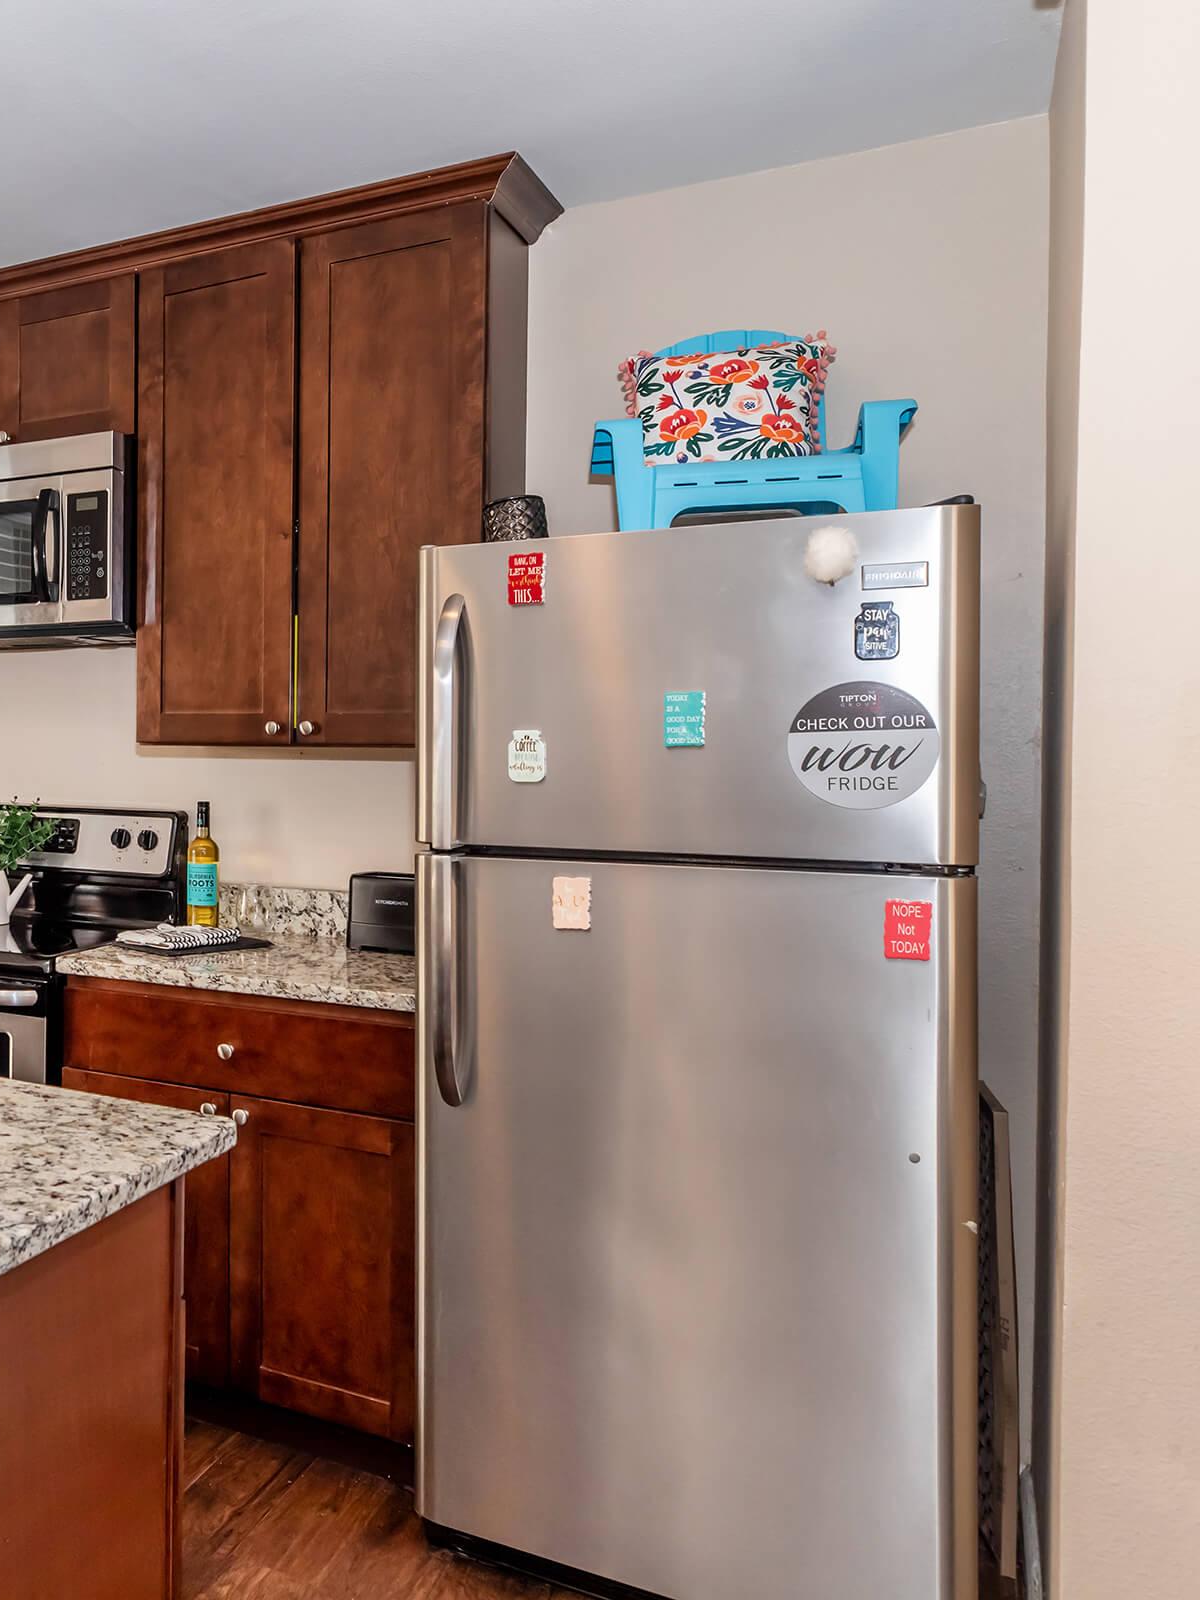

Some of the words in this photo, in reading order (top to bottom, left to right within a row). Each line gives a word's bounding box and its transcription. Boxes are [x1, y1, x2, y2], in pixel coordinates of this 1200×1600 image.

[510, 567, 525, 576] LET
[528, 567, 541, 575] ME
[864, 609, 889, 621] STAY
[839, 693, 877, 703] TIPTON
[796, 717, 848, 731] CHECK
[854, 715, 886, 729] OUT
[891, 714, 926, 727] OUR
[801, 738, 924, 773] wow
[828, 776, 899, 791] FRIDGE
[892, 904, 924, 918] NOPE
[898, 922, 916, 936] Not
[890, 940, 925, 954] TODAY
